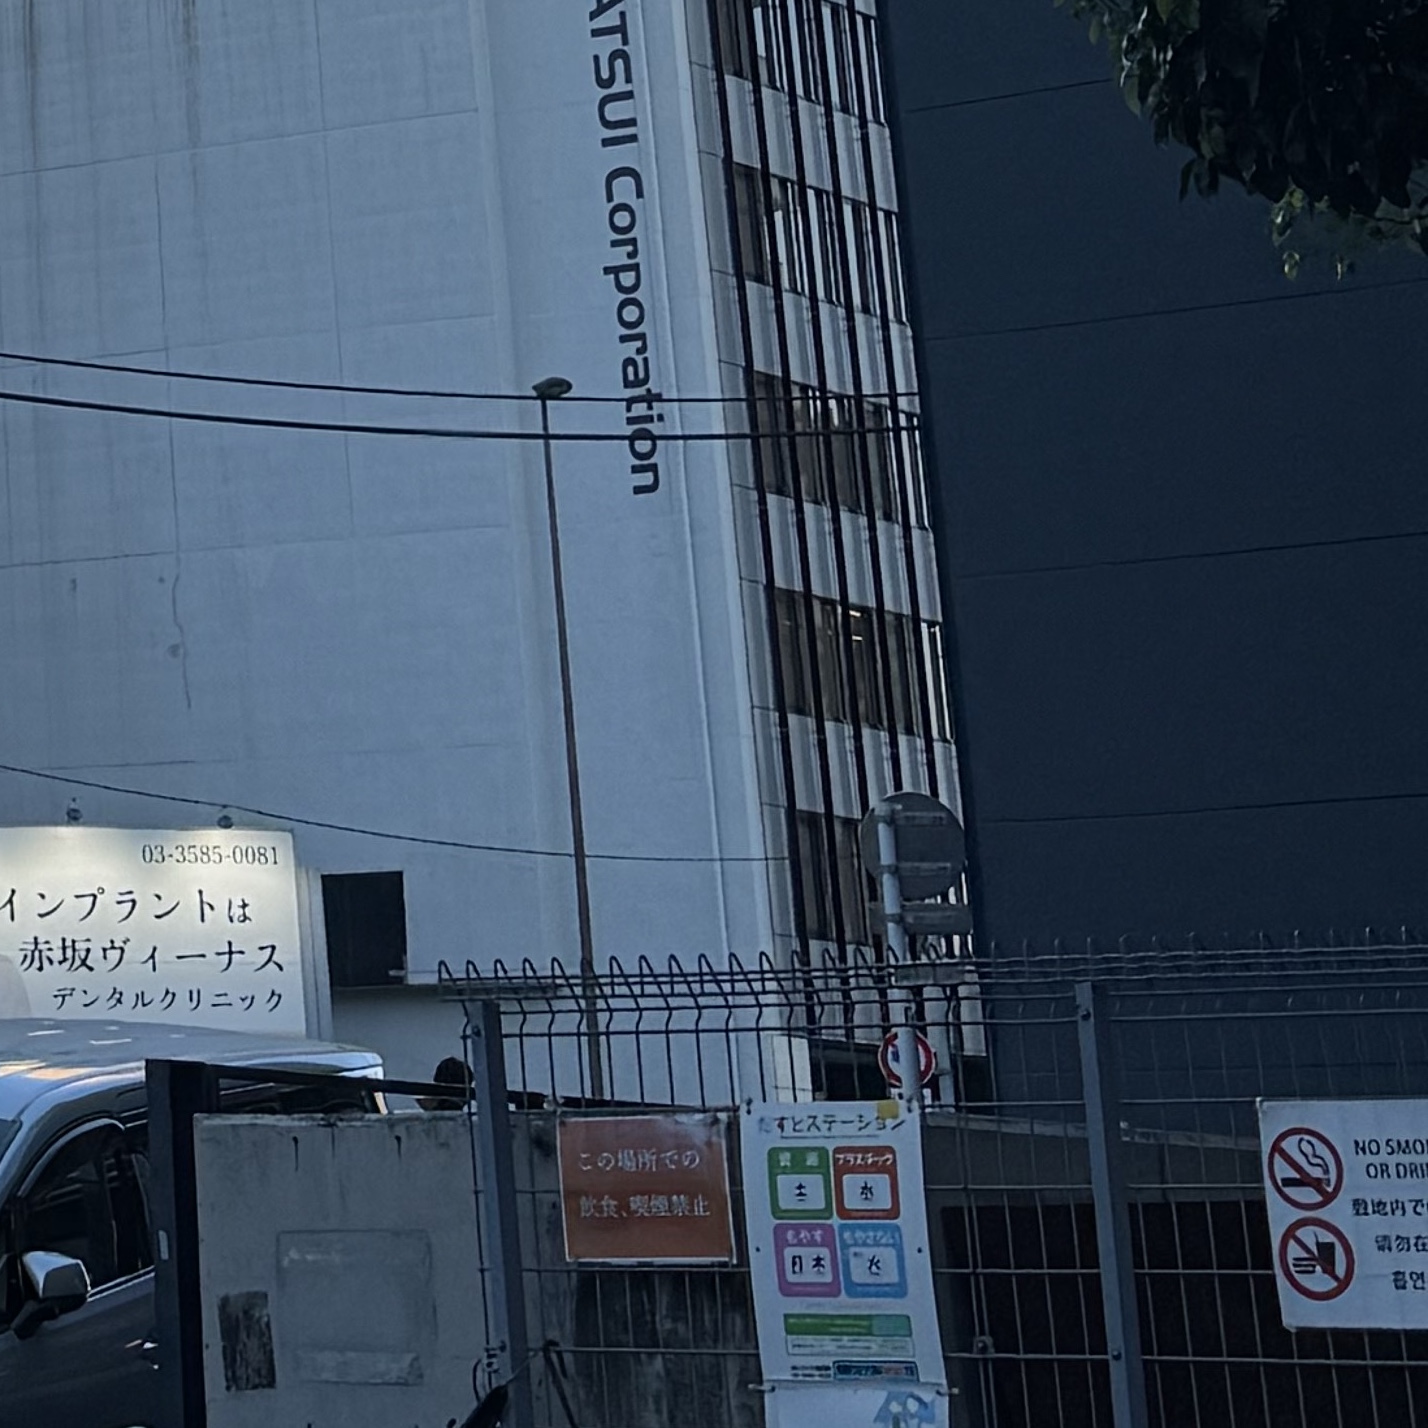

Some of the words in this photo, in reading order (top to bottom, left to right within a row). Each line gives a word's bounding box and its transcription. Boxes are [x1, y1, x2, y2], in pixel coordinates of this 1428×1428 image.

[602, 166, 665, 495] Corporation
[141, 844, 280, 867] 03-3585-0081
[17, 935, 287, 974] 赤坂ヴィーナス
[51, 985, 285, 1012] デンタルクリニック
[1353, 1138, 1381, 1156] NO
[1385, 1138, 1428, 1156] SMO
[578, 1148, 700, 1172] この場所での
[1366, 1161, 1391, 1180] OR
[1394, 1161, 1428, 1180] DRI
[579, 1194, 710, 1218] 飲食、喫煙禁止
[1351, 1197, 1428, 1217] 敷地内で
